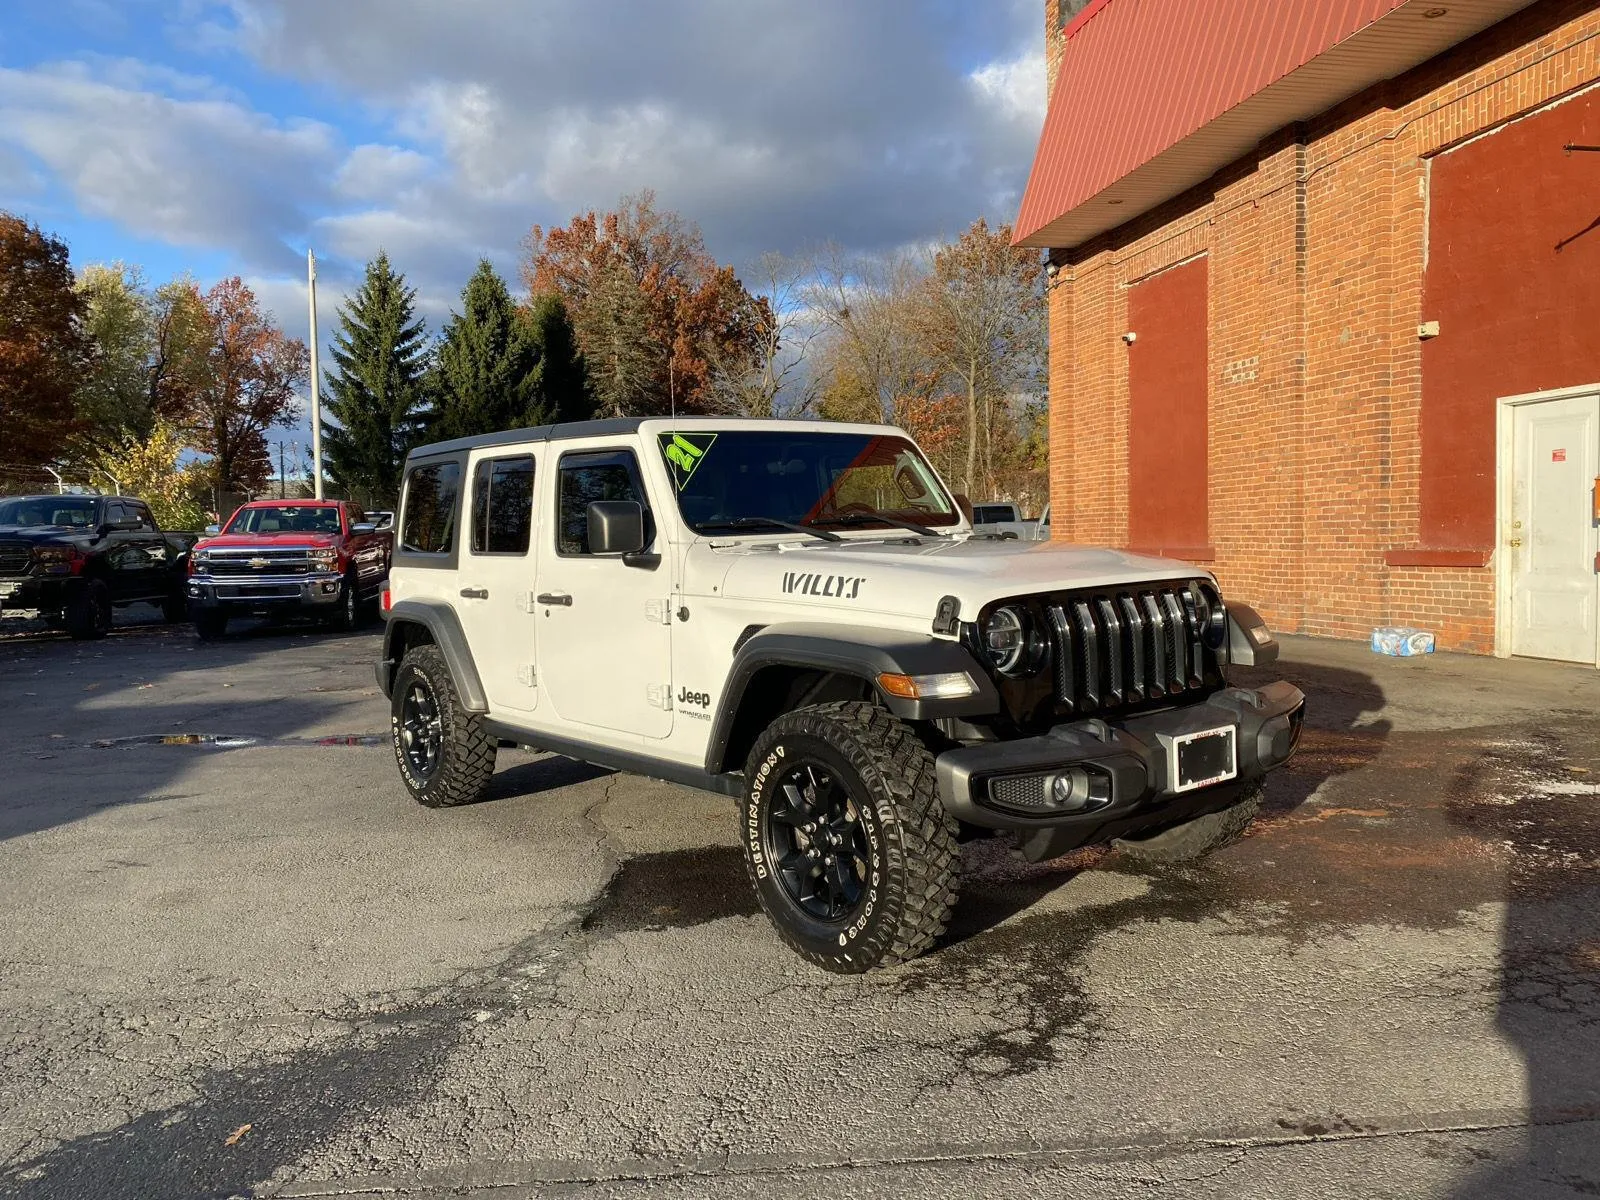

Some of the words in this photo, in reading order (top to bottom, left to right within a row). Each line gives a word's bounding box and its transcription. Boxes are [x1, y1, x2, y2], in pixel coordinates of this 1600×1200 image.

[782, 572, 867, 599] WILLYS
[677, 686, 711, 709] Jeep
[749, 753, 778, 880] DESTINATION
